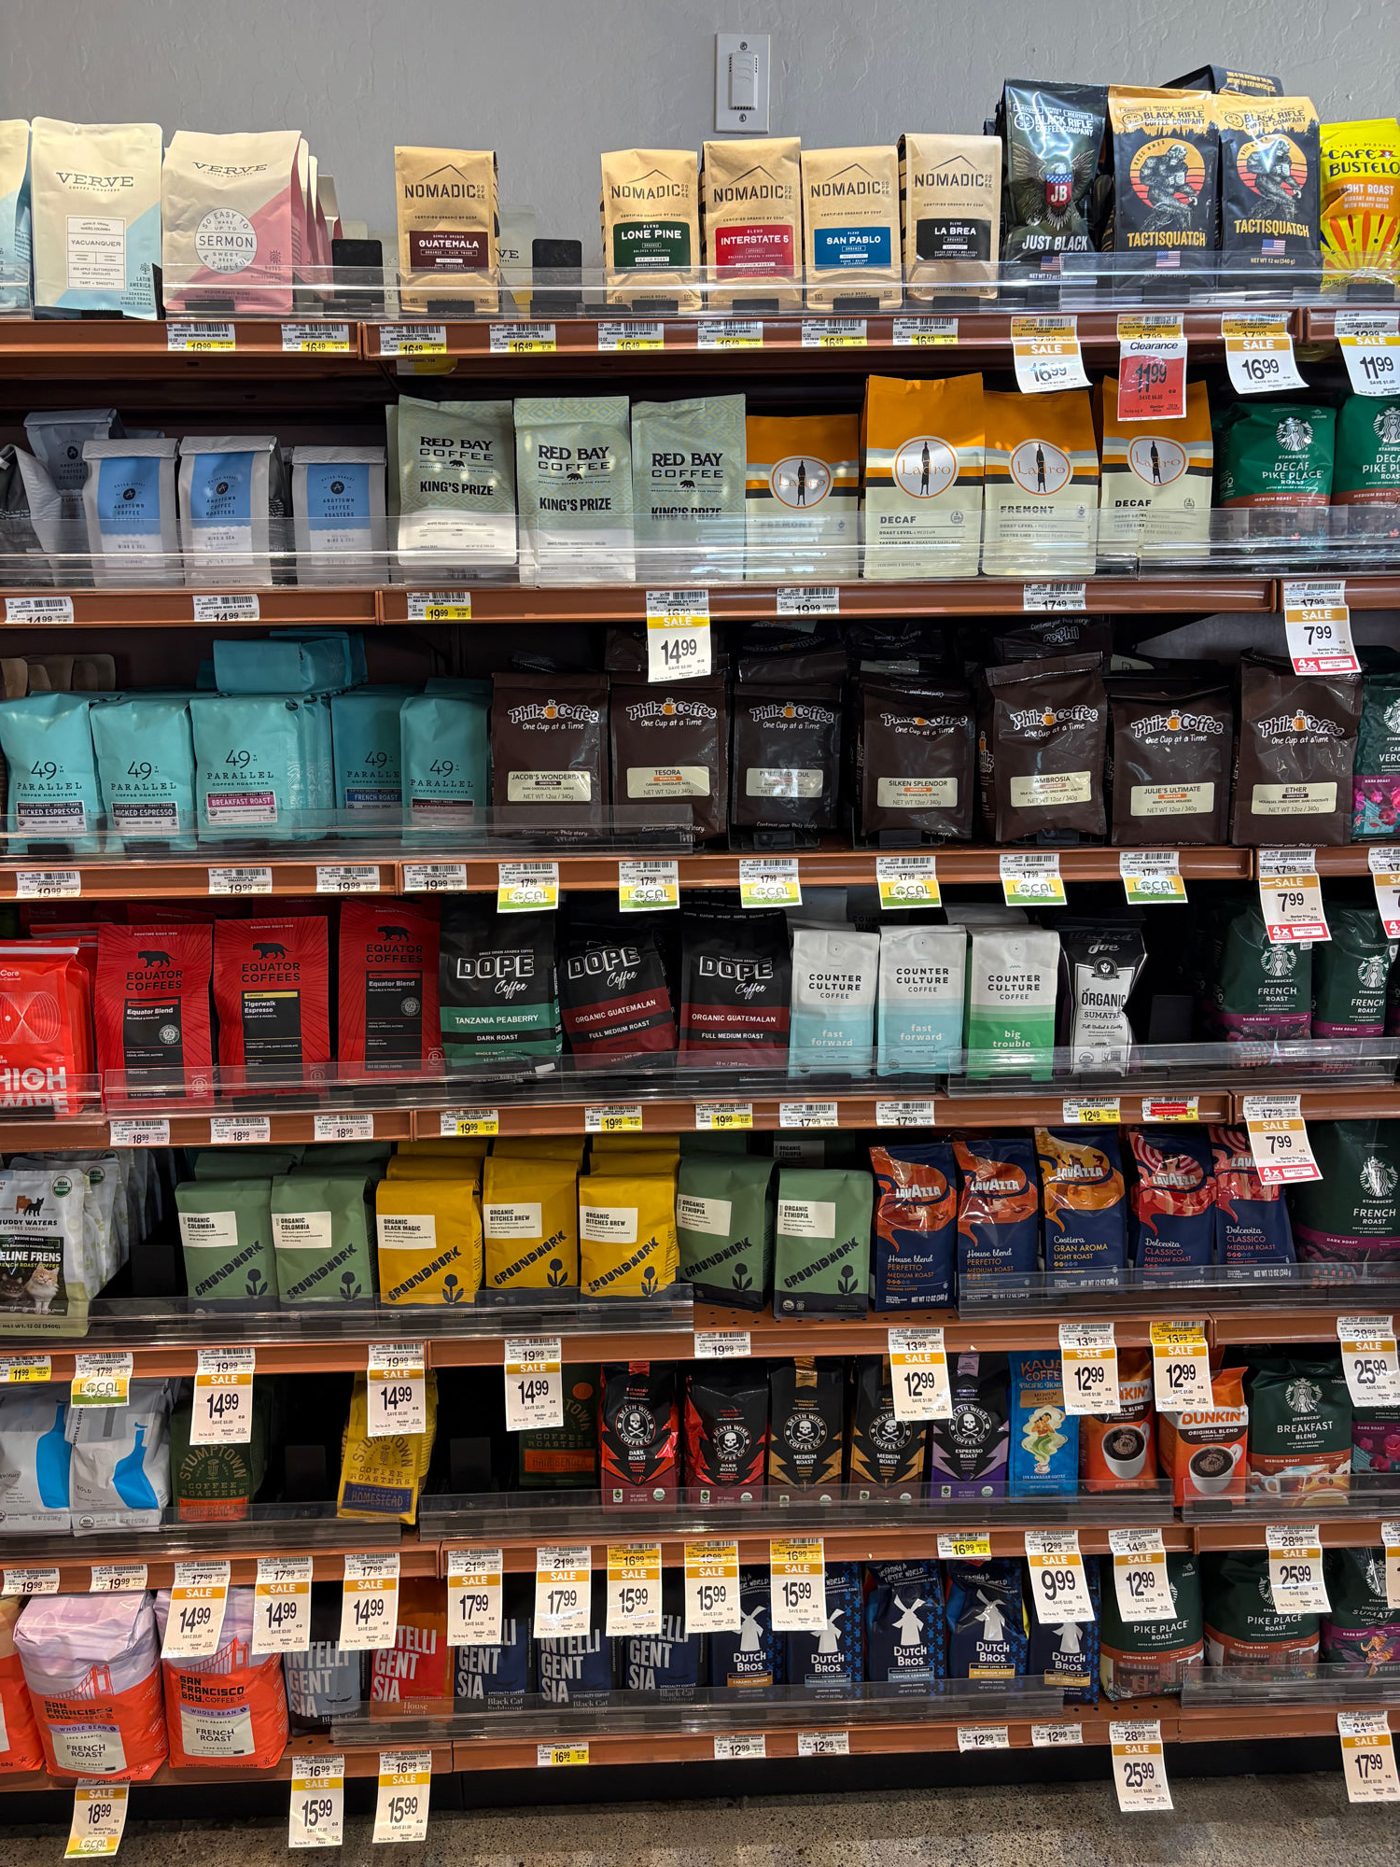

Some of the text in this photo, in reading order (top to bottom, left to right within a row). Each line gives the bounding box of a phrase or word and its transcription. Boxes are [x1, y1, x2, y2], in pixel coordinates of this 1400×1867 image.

[1143, 110, 1205, 120] BLACK RIFLE
[192, 161, 268, 176] VERVE
[1330, 161, 1400, 178] BUSTELO
[56, 172, 134, 189] VERVE
[915, 173, 984, 190] NOMADIC
[404, 184, 476, 200] NOMADIC
[611, 183, 680, 200] NOMADIC
[714, 184, 784, 203] NOMADIC
[1051, 184, 1068, 202] JB
[1367, 183, 1395, 197] ROAST
[934, 226, 977, 236] LA BREA
[1234, 219, 1310, 239] TACTISQUATCH
[621, 229, 682, 241] LONE PINE
[720, 235, 790, 245] INTERSTATE 5
[826, 235, 881, 246] SAN PABLO
[1127, 231, 1208, 249] TACTISQUATCH
[71, 239, 122, 248] YACUANQUER
[198, 235, 254, 249] SERMON
[419, 239, 480, 249] GUATEMALA
[1022, 236, 1088, 252] JUST BLACK
[1030, 343, 1062, 355] SALE
[1130, 341, 1179, 352] Clearance
[1243, 338, 1275, 350] SALE
[420, 436, 494, 451] RED BAY
[419, 448, 494, 462] COFFEE
[538, 444, 610, 461] RED BAY
[538, 460, 610, 472] COFFEE
[1275, 461, 1310, 472] DECAF
[1262, 470, 1322, 481] PIKE PLACE
[420, 480, 495, 496] KING'S PRIZE
[539, 497, 612, 512] KING'S PRIZE
[1000, 504, 1055, 514] FREMONT
[1115, 499, 1152, 509] DECAF
[880, 514, 917, 525] DECAF
[1301, 610, 1332, 621] SALE
[663, 616, 693, 627] SALE
[507, 703, 599, 724] Philz Coffee
[626, 701, 718, 720] Philz Coffee
[523, 723, 537, 731] One
[538, 723, 550, 734] Cup
[551, 723, 559, 731] at
[568, 721, 584, 730] Time
[1131, 713, 1225, 739] Philz Coffee
[226, 749, 251, 768] 49
[127, 761, 152, 781] 49
[207, 771, 274, 780] PARALLEL
[654, 768, 682, 777] TESORA
[511, 773, 540, 781] JACOB'S
[1034, 774, 1071, 784] AMBROSIA
[16, 782, 82, 791] PARALLEL
[111, 783, 177, 792] PARALLEL
[888, 779, 948, 788] SILKEN SPLENDOR
[1143, 785, 1202, 795] JULIE'S ULTIMATE
[1284, 786, 1308, 794] ETHER
[211, 797, 272, 806] BREAKFAST ROAST
[354, 793, 399, 801] FRENCH ROAST
[1274, 876, 1304, 888] SALE
[456, 954, 535, 979] DOPE
[567, 946, 641, 980] DOPE
[698, 954, 774, 981] DOPE
[126, 970, 184, 981] EQUATOR
[809, 974, 862, 982] COUNTER
[988, 974, 1041, 983] COUNTER
[125, 979, 183, 992] COFFEES
[494, 979, 529, 1000] Coffee
[808, 982, 861, 991] CULTURE
[988, 983, 1040, 992] CULTURE
[1258, 987, 1297, 996] FRENCH
[244, 1000, 276, 1009] Tigerwalk
[1081, 989, 1127, 1009] ORGANIC
[127, 1006, 174, 1016] Equator Blend
[244, 1007, 273, 1015] Espresso
[575, 999, 658, 1025] ORGANIC GUATEMALAN
[455, 1014, 539, 1025] TANZANIA PEABERRY
[476, 1034, 495, 1042] DARK
[701, 1032, 765, 1041] FULL MEDIUM ROAST
[822, 1030, 843, 1038] fast
[1004, 1029, 1021, 1041] big
[811, 1038, 853, 1047] forward
[992, 1039, 1031, 1048] trouble
[1262, 1120, 1290, 1131] SALE
[1056, 1166, 1104, 1179] LAVAZZA
[895, 1183, 942, 1199] LAVAZZA
[489, 1214, 530, 1222] BITCHES BREW
[783, 1211, 810, 1219] ETHIOPIA
[1353, 1207, 1397, 1218] FRENCH
[26, 1219, 58, 1227] WATERS
[186, 1216, 211, 1224] ORGANIC
[1362, 1217, 1387, 1225] ROAST
[384, 1224, 421, 1232] BLACK MAGIC
[1053, 1235, 1086, 1245] Costiera
[1226, 1234, 1266, 1244] CLASSICO
[1053, 1243, 1109, 1252] GRAN AROMA
[30, 1250, 62, 1263] FRENS
[494, 1230, 568, 1287] GROUNDWORK
[784, 1237, 859, 1289] GROUNDWORK
[887, 1263, 923, 1272] PERFETTO
[194, 1240, 265, 1299] GROUNDWORK
[388, 1245, 463, 1303] GROUNDWORK
[904, 1353, 932, 1363] SALE
[211, 1375, 238, 1386] SALE
[1181, 1411, 1246, 1426] DUNKIN'
[1187, 1427, 1239, 1437] ORIGINAL BLEND
[1276, 1420, 1334, 1433] BREAKFAST
[792, 1453, 818, 1461] MEDIUM
[351, 1491, 404, 1507] HOMESTEAD
[462, 1575, 489, 1586] SALE
[1133, 1620, 1188, 1634] PIKE PLACE
[893, 1645, 928, 1657] DUTCH
[375, 1652, 420, 1681] GENT
[897, 1656, 925, 1667] BROS
[180, 1685, 245, 1696] FRANCISCO
[372, 1680, 401, 1703] SIA
[195, 1727, 236, 1738] FRENCH
